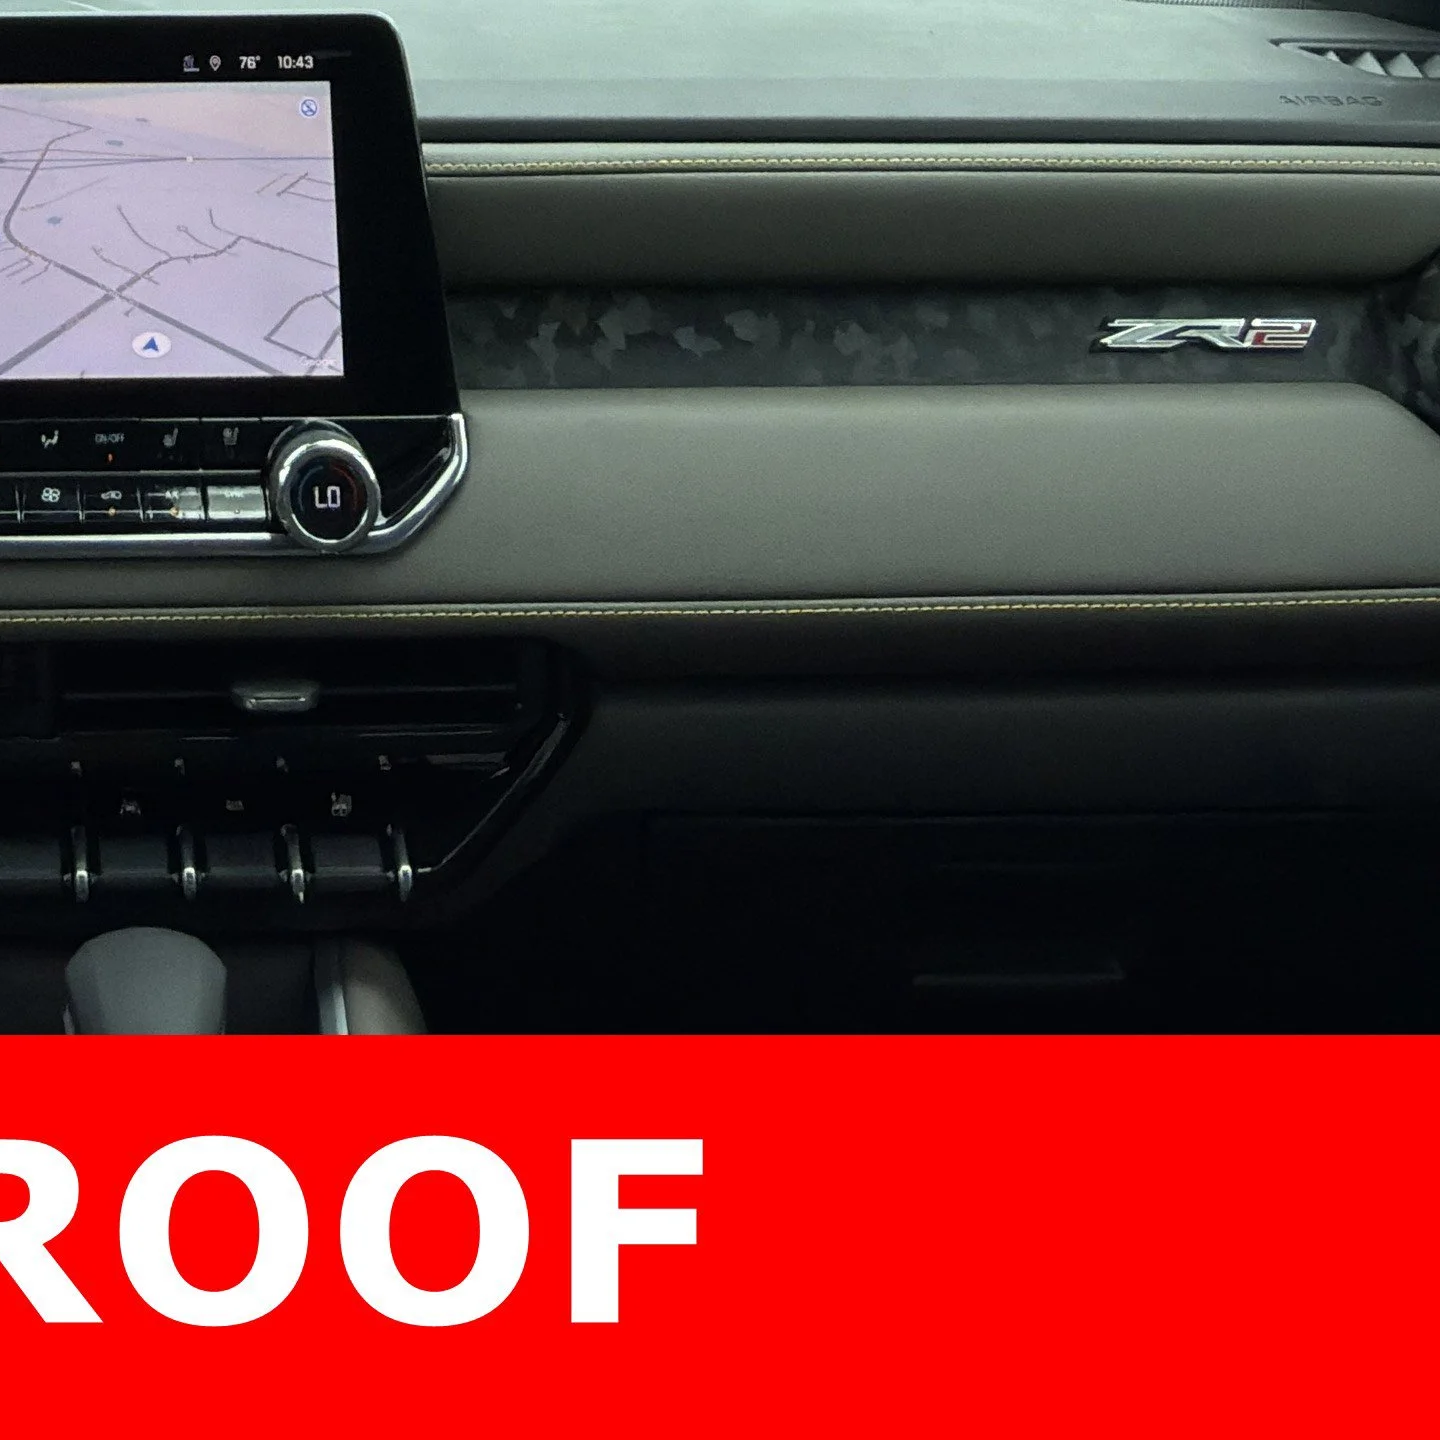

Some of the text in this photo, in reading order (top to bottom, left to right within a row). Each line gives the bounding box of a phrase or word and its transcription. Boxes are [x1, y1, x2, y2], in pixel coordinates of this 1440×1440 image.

[239, 55, 261, 70] 76°
[277, 55, 314, 70] 10:43
[1092, 316, 1318, 352] ZR2
[95, 433, 124, 444] ON/OFF
[314, 486, 340, 508] LO
